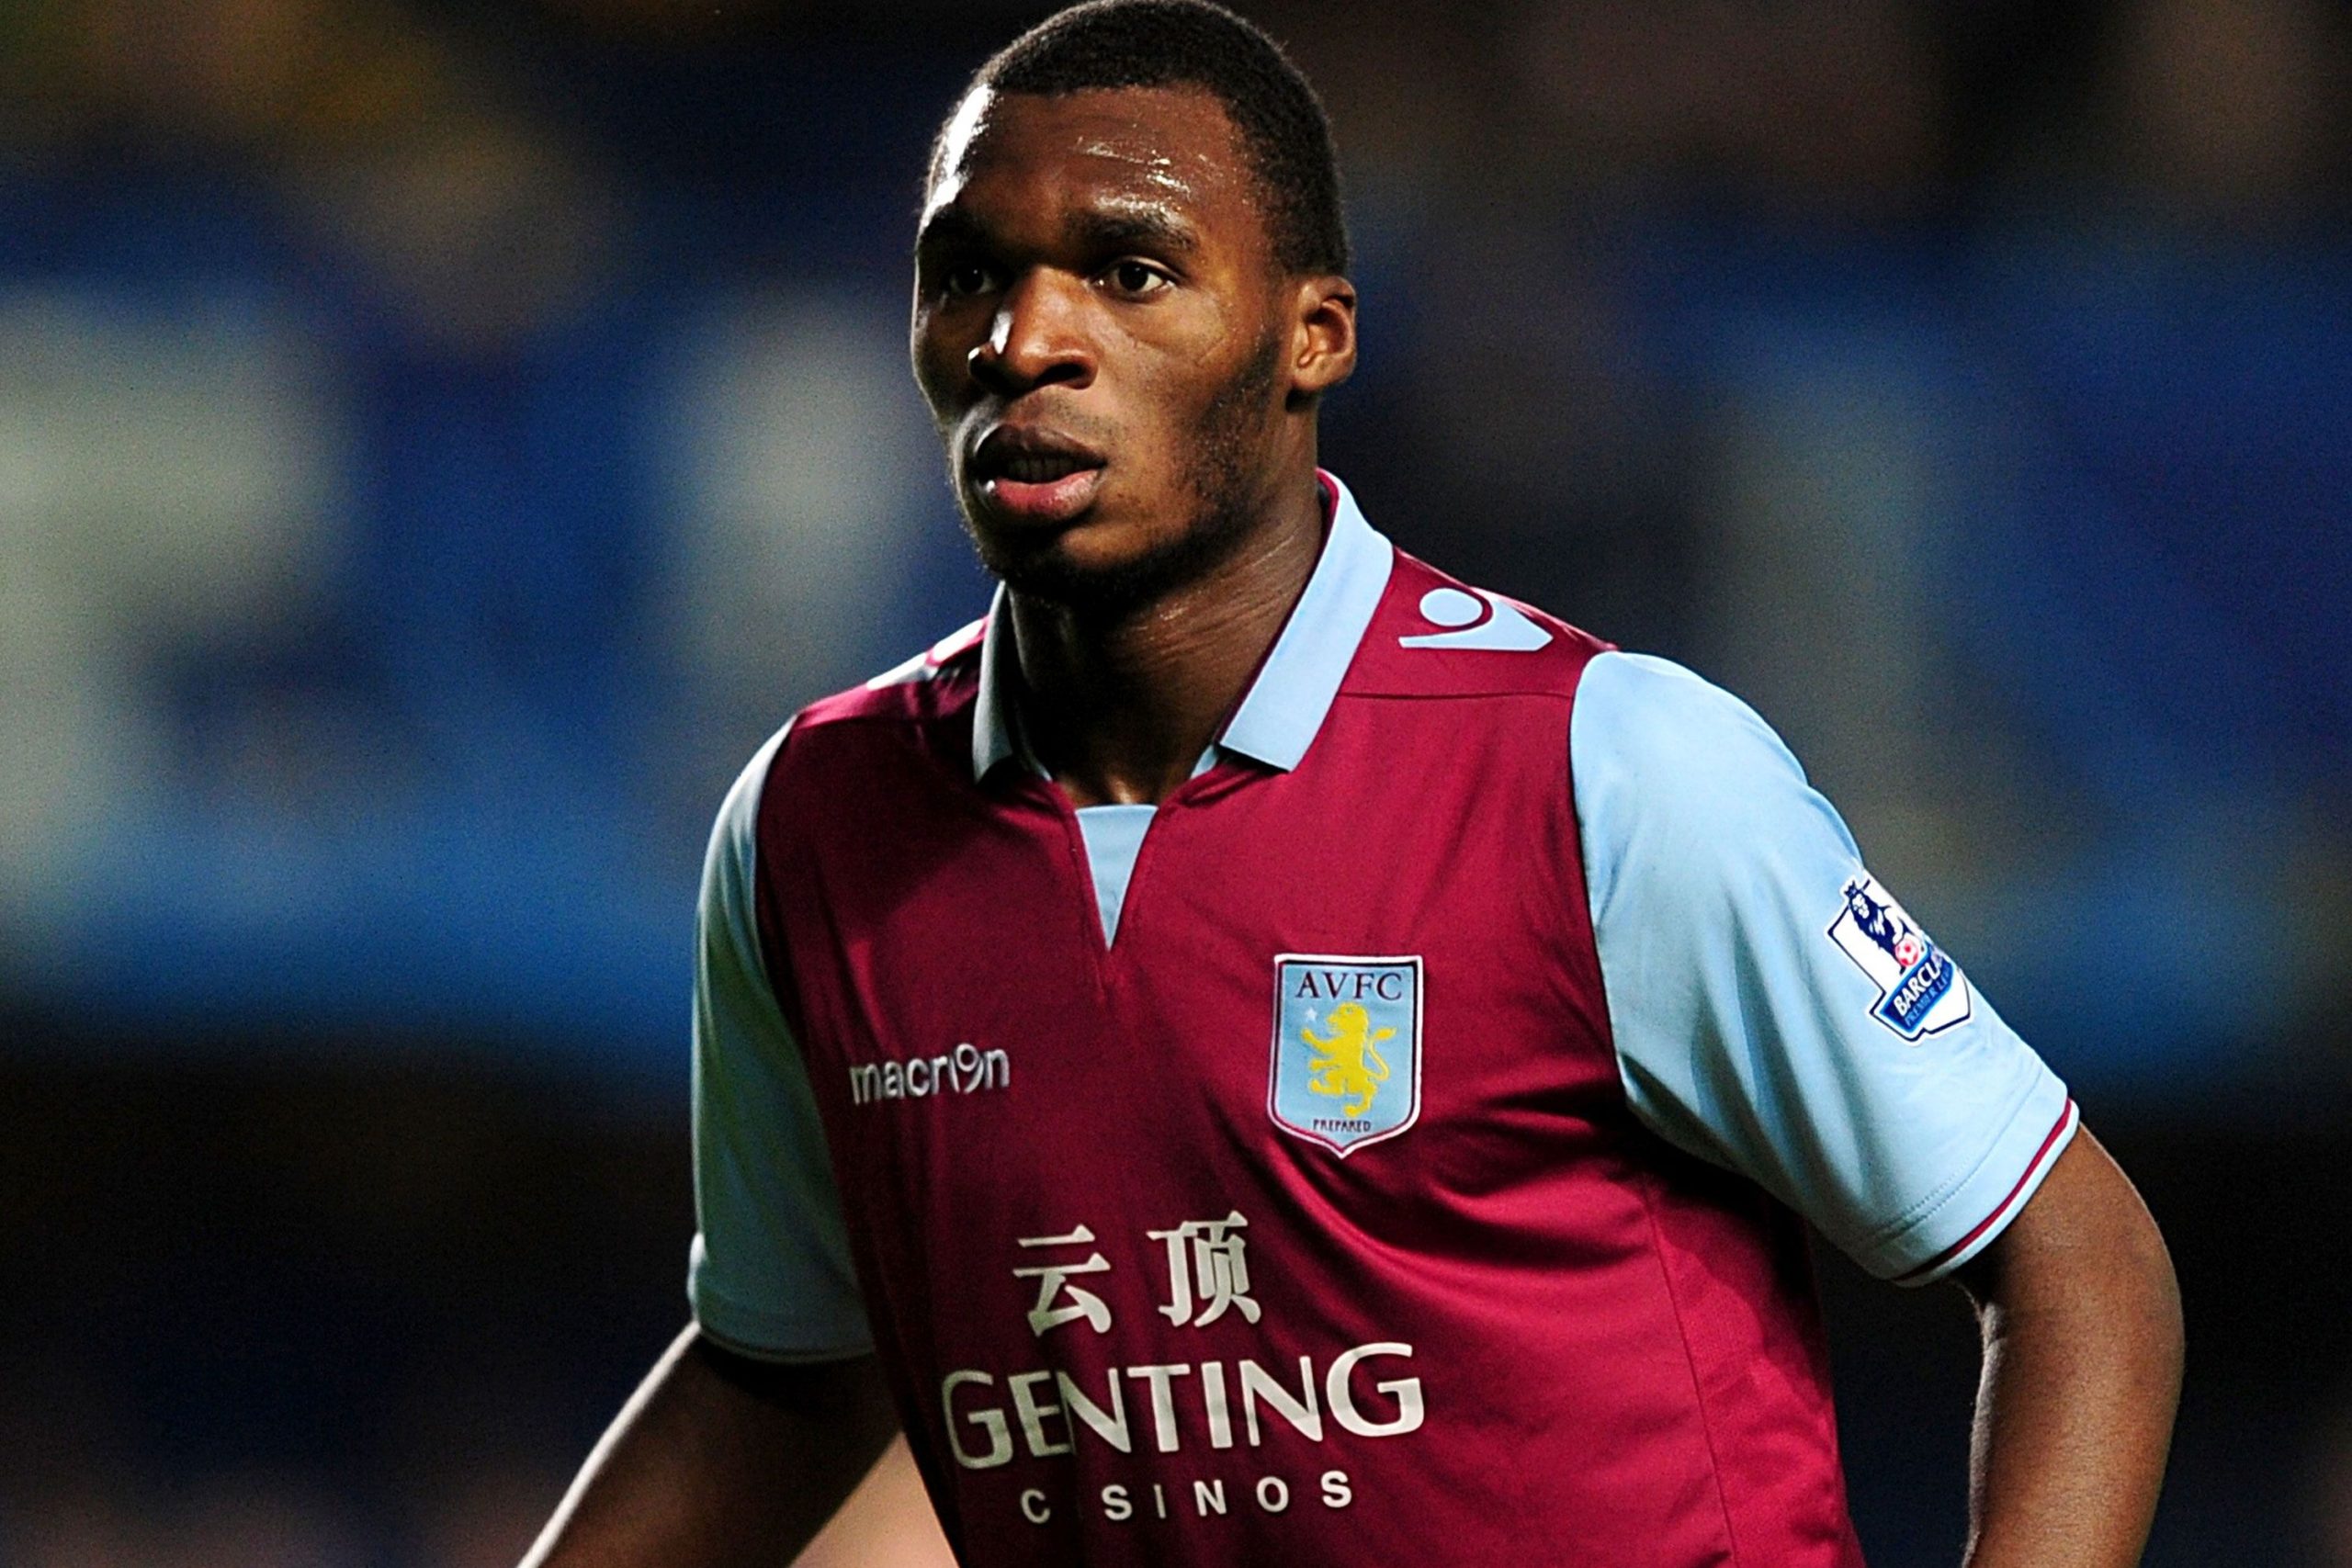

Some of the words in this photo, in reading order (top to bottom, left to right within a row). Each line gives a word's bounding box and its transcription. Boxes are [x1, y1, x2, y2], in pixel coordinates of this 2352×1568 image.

[1295, 971, 1402, 1000] AVFC
[1893, 945, 1944, 1017] BARCL
[1313, 1119, 1371, 1132] PREPARED
[1012, 1210, 1261, 1337] 云顶
[941, 1342, 1425, 1470] GENTING
[1020, 1470, 1353, 1524] CSINOS
